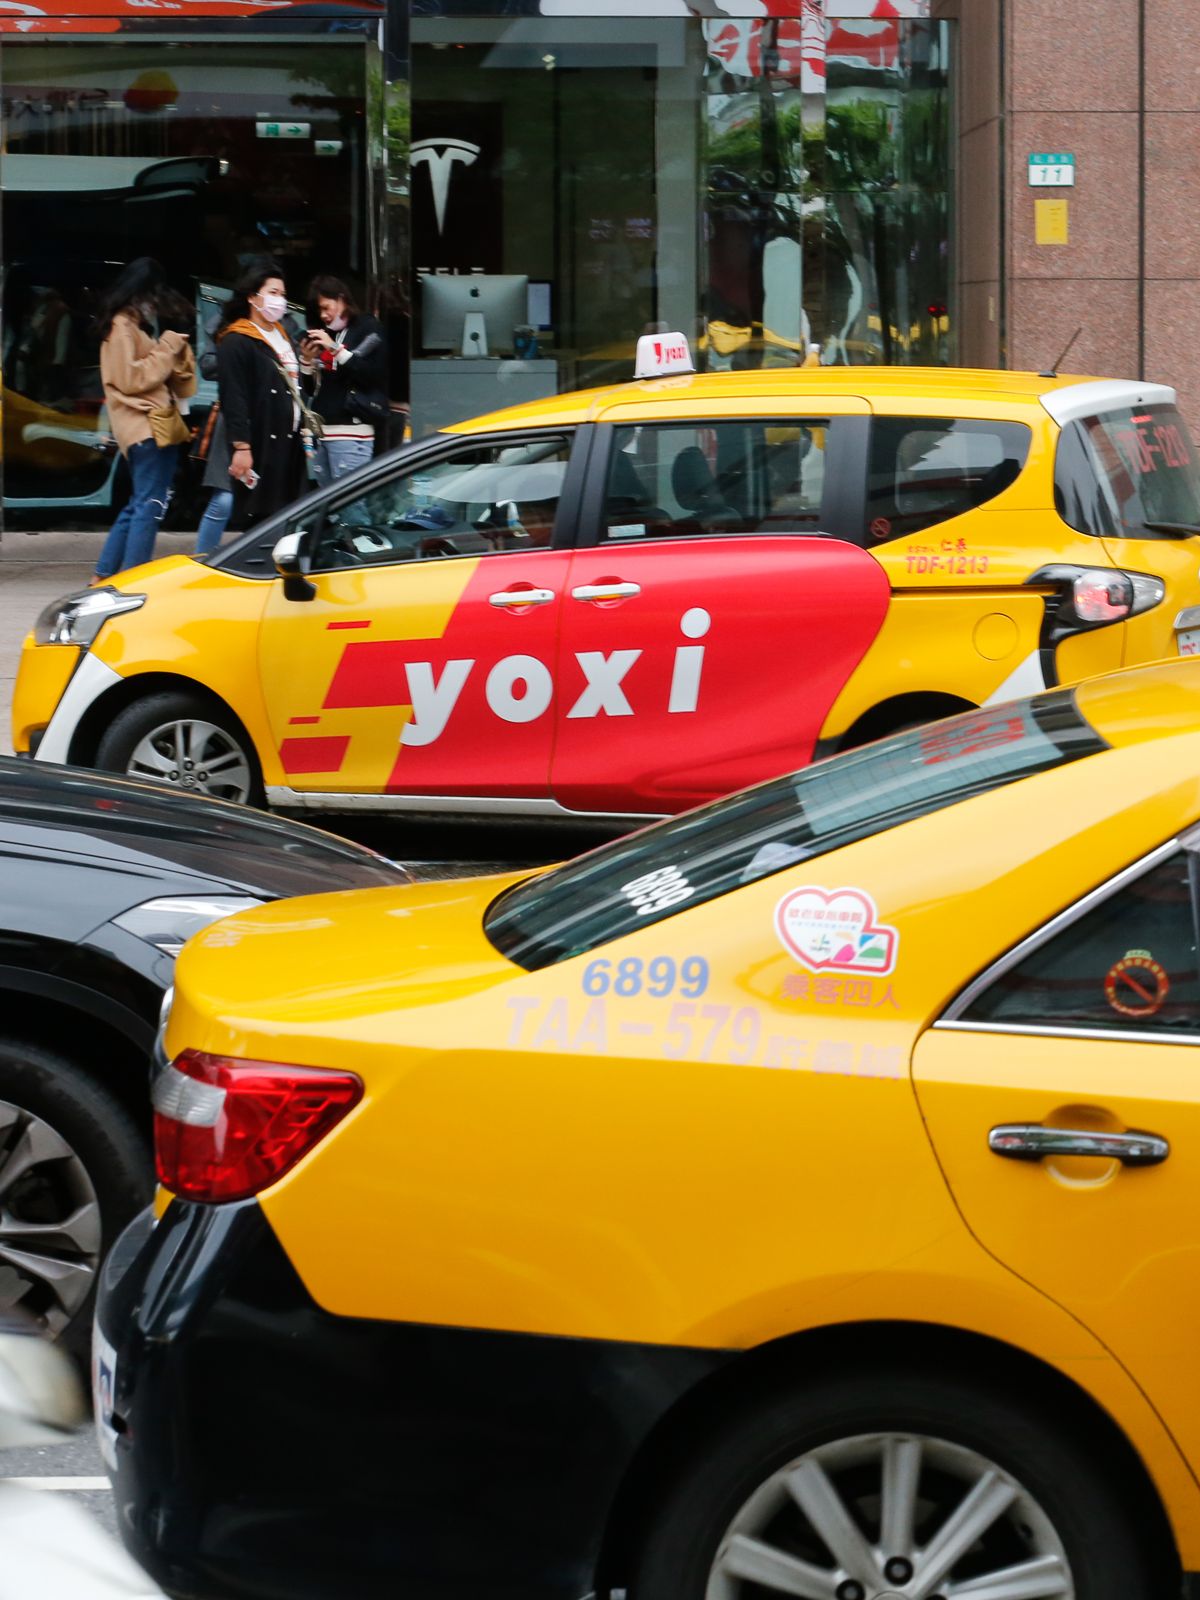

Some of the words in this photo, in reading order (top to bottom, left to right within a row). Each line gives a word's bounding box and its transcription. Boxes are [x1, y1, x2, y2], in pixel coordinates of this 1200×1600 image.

[1040, 168, 1061, 182] 11
[906, 555, 989, 574] TDF-1213
[399, 607, 711, 746] yoxi
[582, 956, 710, 998] 6899
[780, 973, 901, 1010] 乘客四人
[505, 995, 764, 1065] TAA-579
